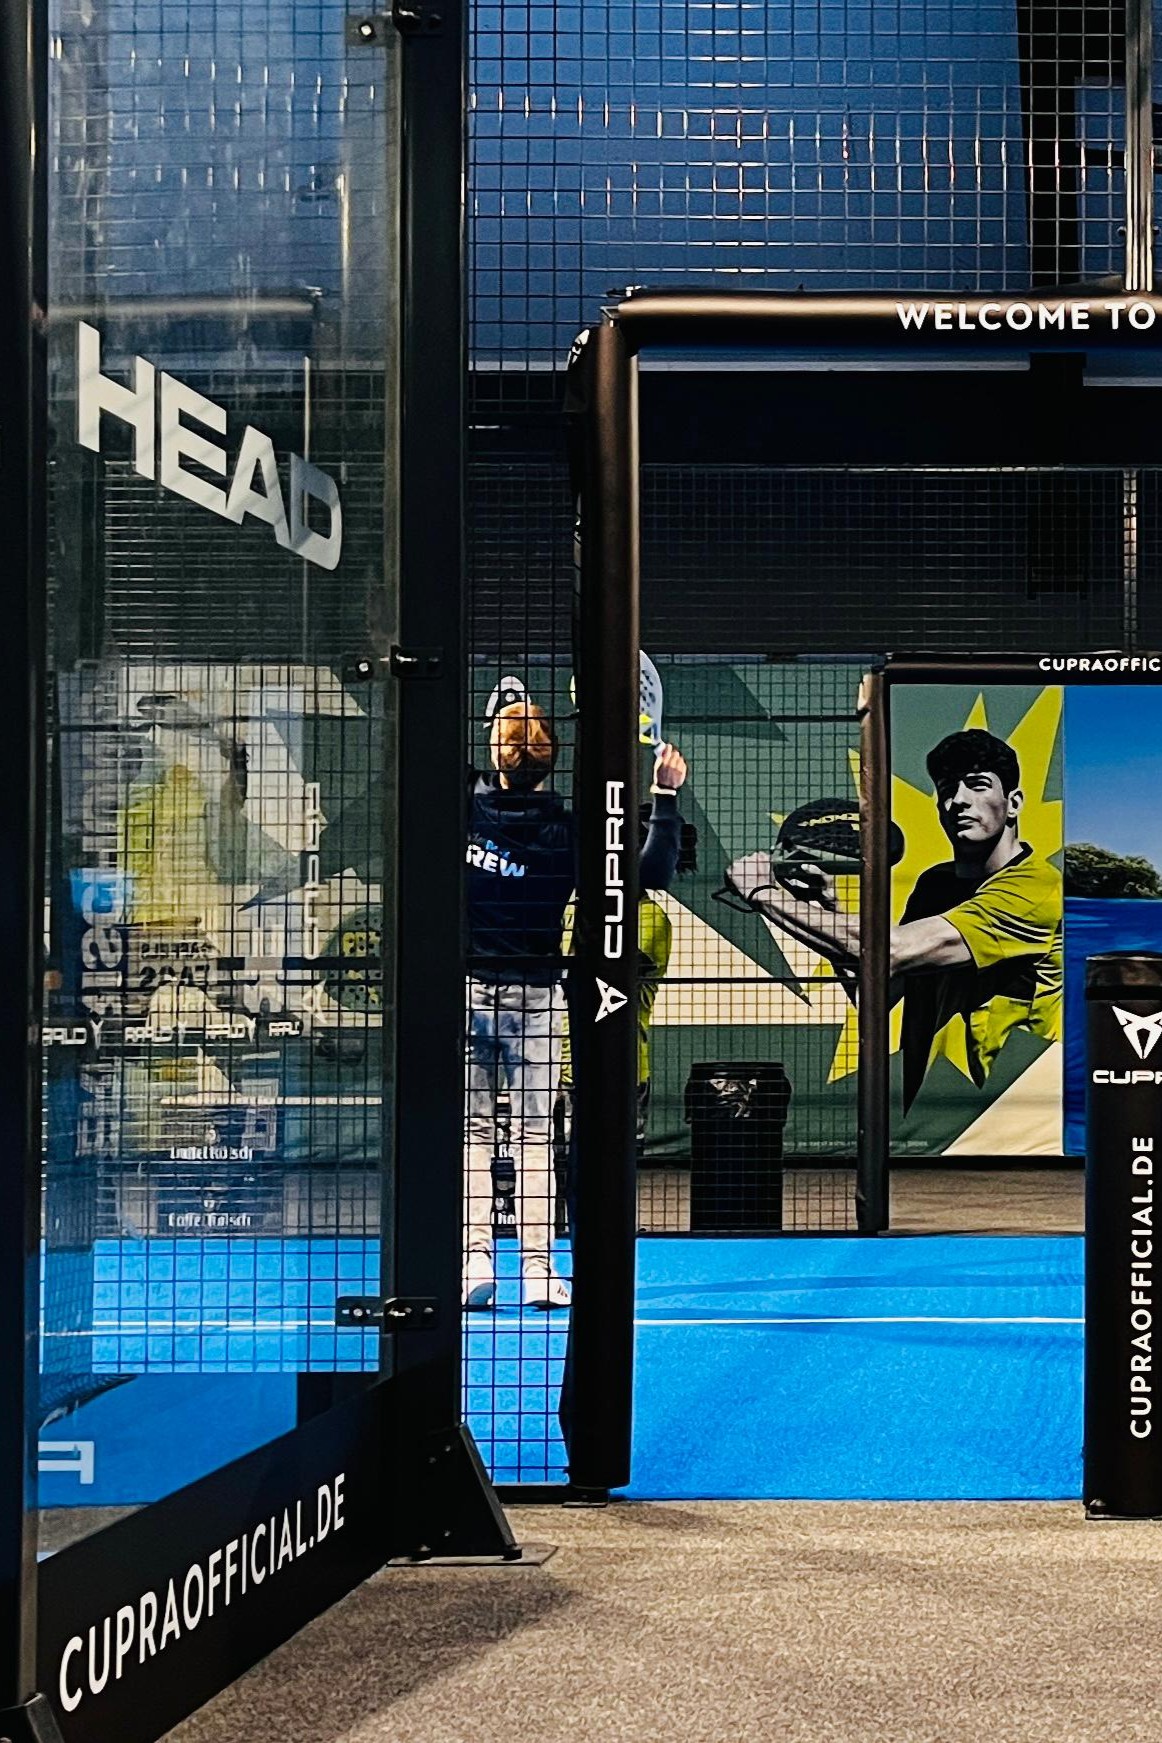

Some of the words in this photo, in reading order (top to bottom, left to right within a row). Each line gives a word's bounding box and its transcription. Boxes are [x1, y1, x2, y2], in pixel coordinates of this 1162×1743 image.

[896, 303, 1090, 331] WELCOME
[1105, 302, 1157, 330] TO
[77, 321, 343, 572] HEAD
[604, 780, 625, 959] CUPRA
[1129, 1137, 1154, 1439] CUPRAOFFICIAL.DE
[58, 1473, 346, 1712] CUPRAOFFICIAL.DE
